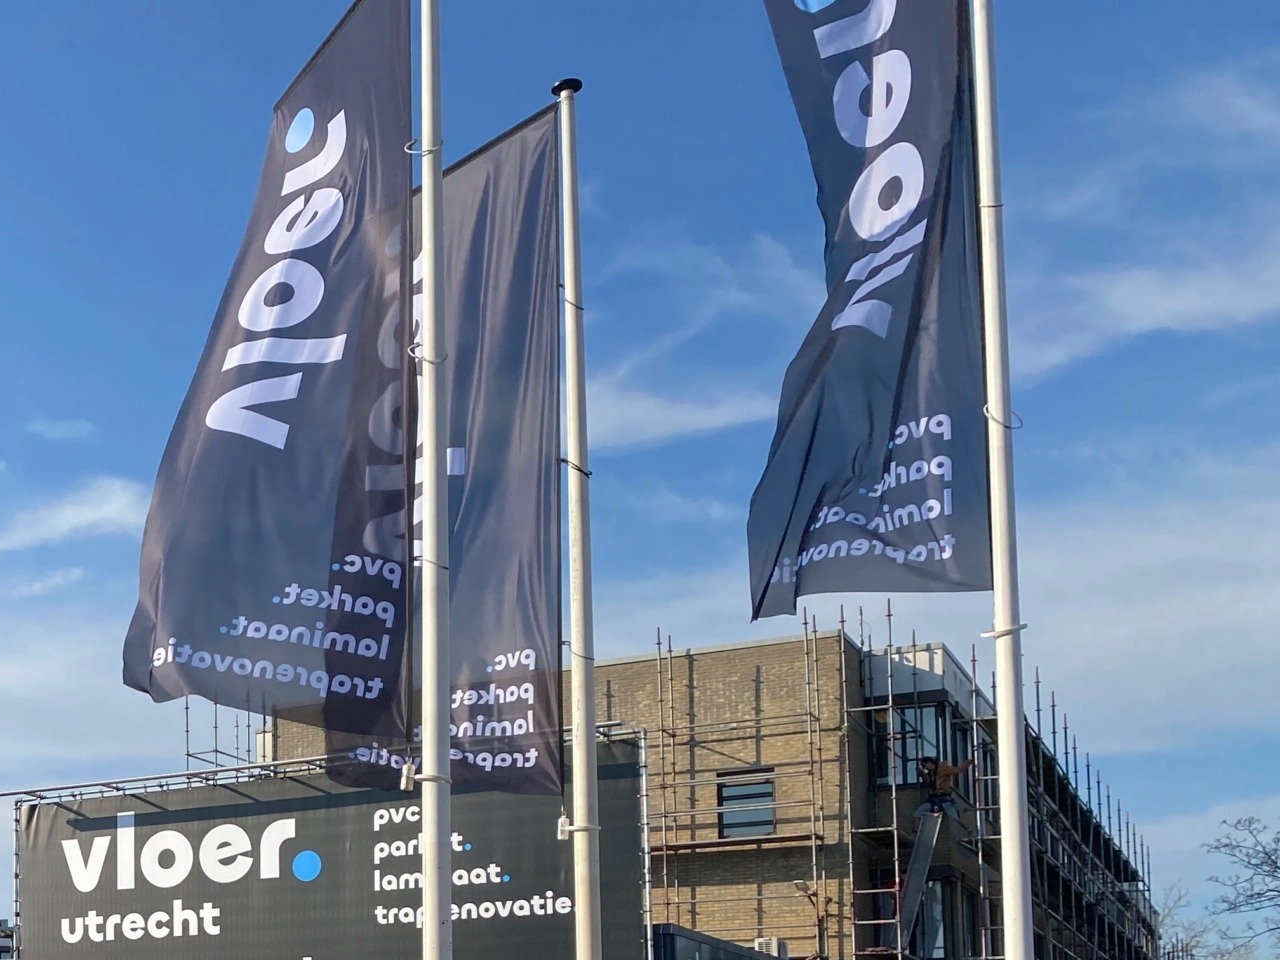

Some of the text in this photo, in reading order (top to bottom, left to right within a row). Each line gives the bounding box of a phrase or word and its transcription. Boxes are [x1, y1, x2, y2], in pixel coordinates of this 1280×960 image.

[61, 811, 322, 894] vloer.
[373, 831, 472, 865] part.
[373, 862, 511, 892] lamaat.
[61, 899, 221, 944] utrecht
